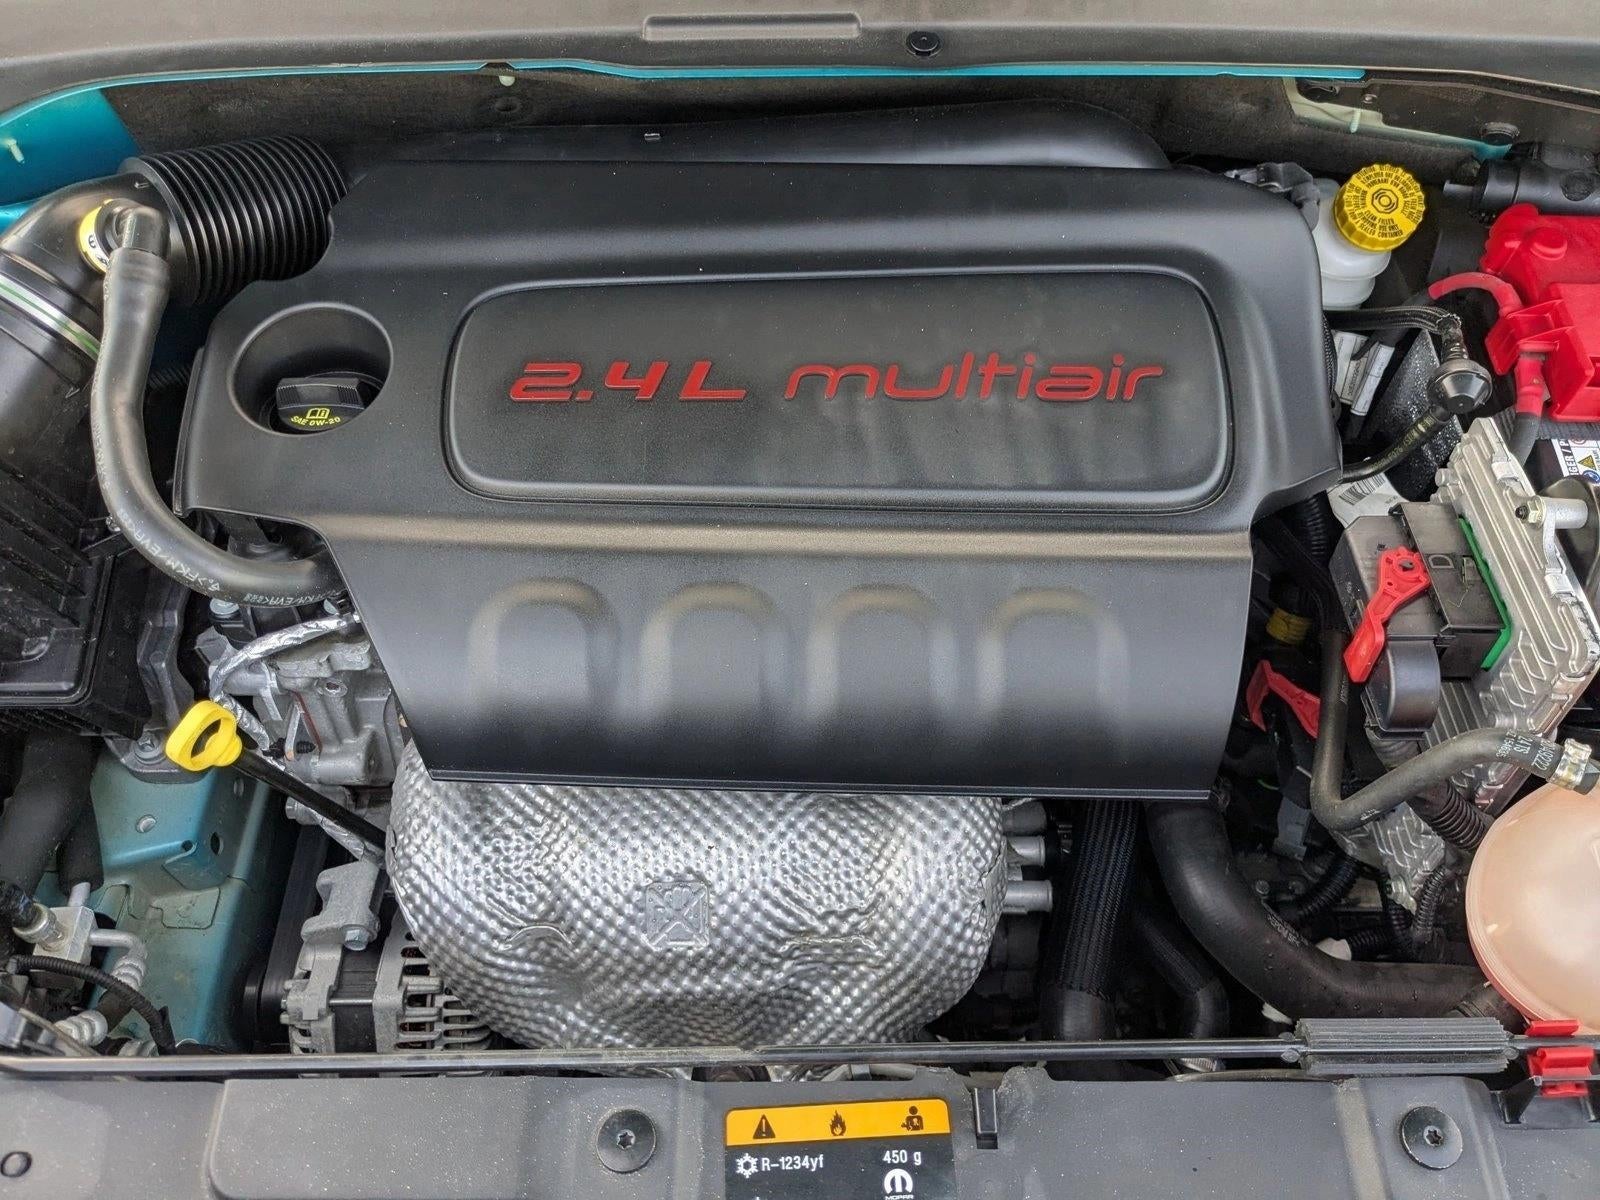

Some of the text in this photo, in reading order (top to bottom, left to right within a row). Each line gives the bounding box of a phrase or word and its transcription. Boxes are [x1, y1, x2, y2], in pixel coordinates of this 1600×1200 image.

[784, 352, 1164, 400] multiair
[290, 415, 307, 426] SAE
[761, 1149, 922, 1172] R-1234yf 450 g
